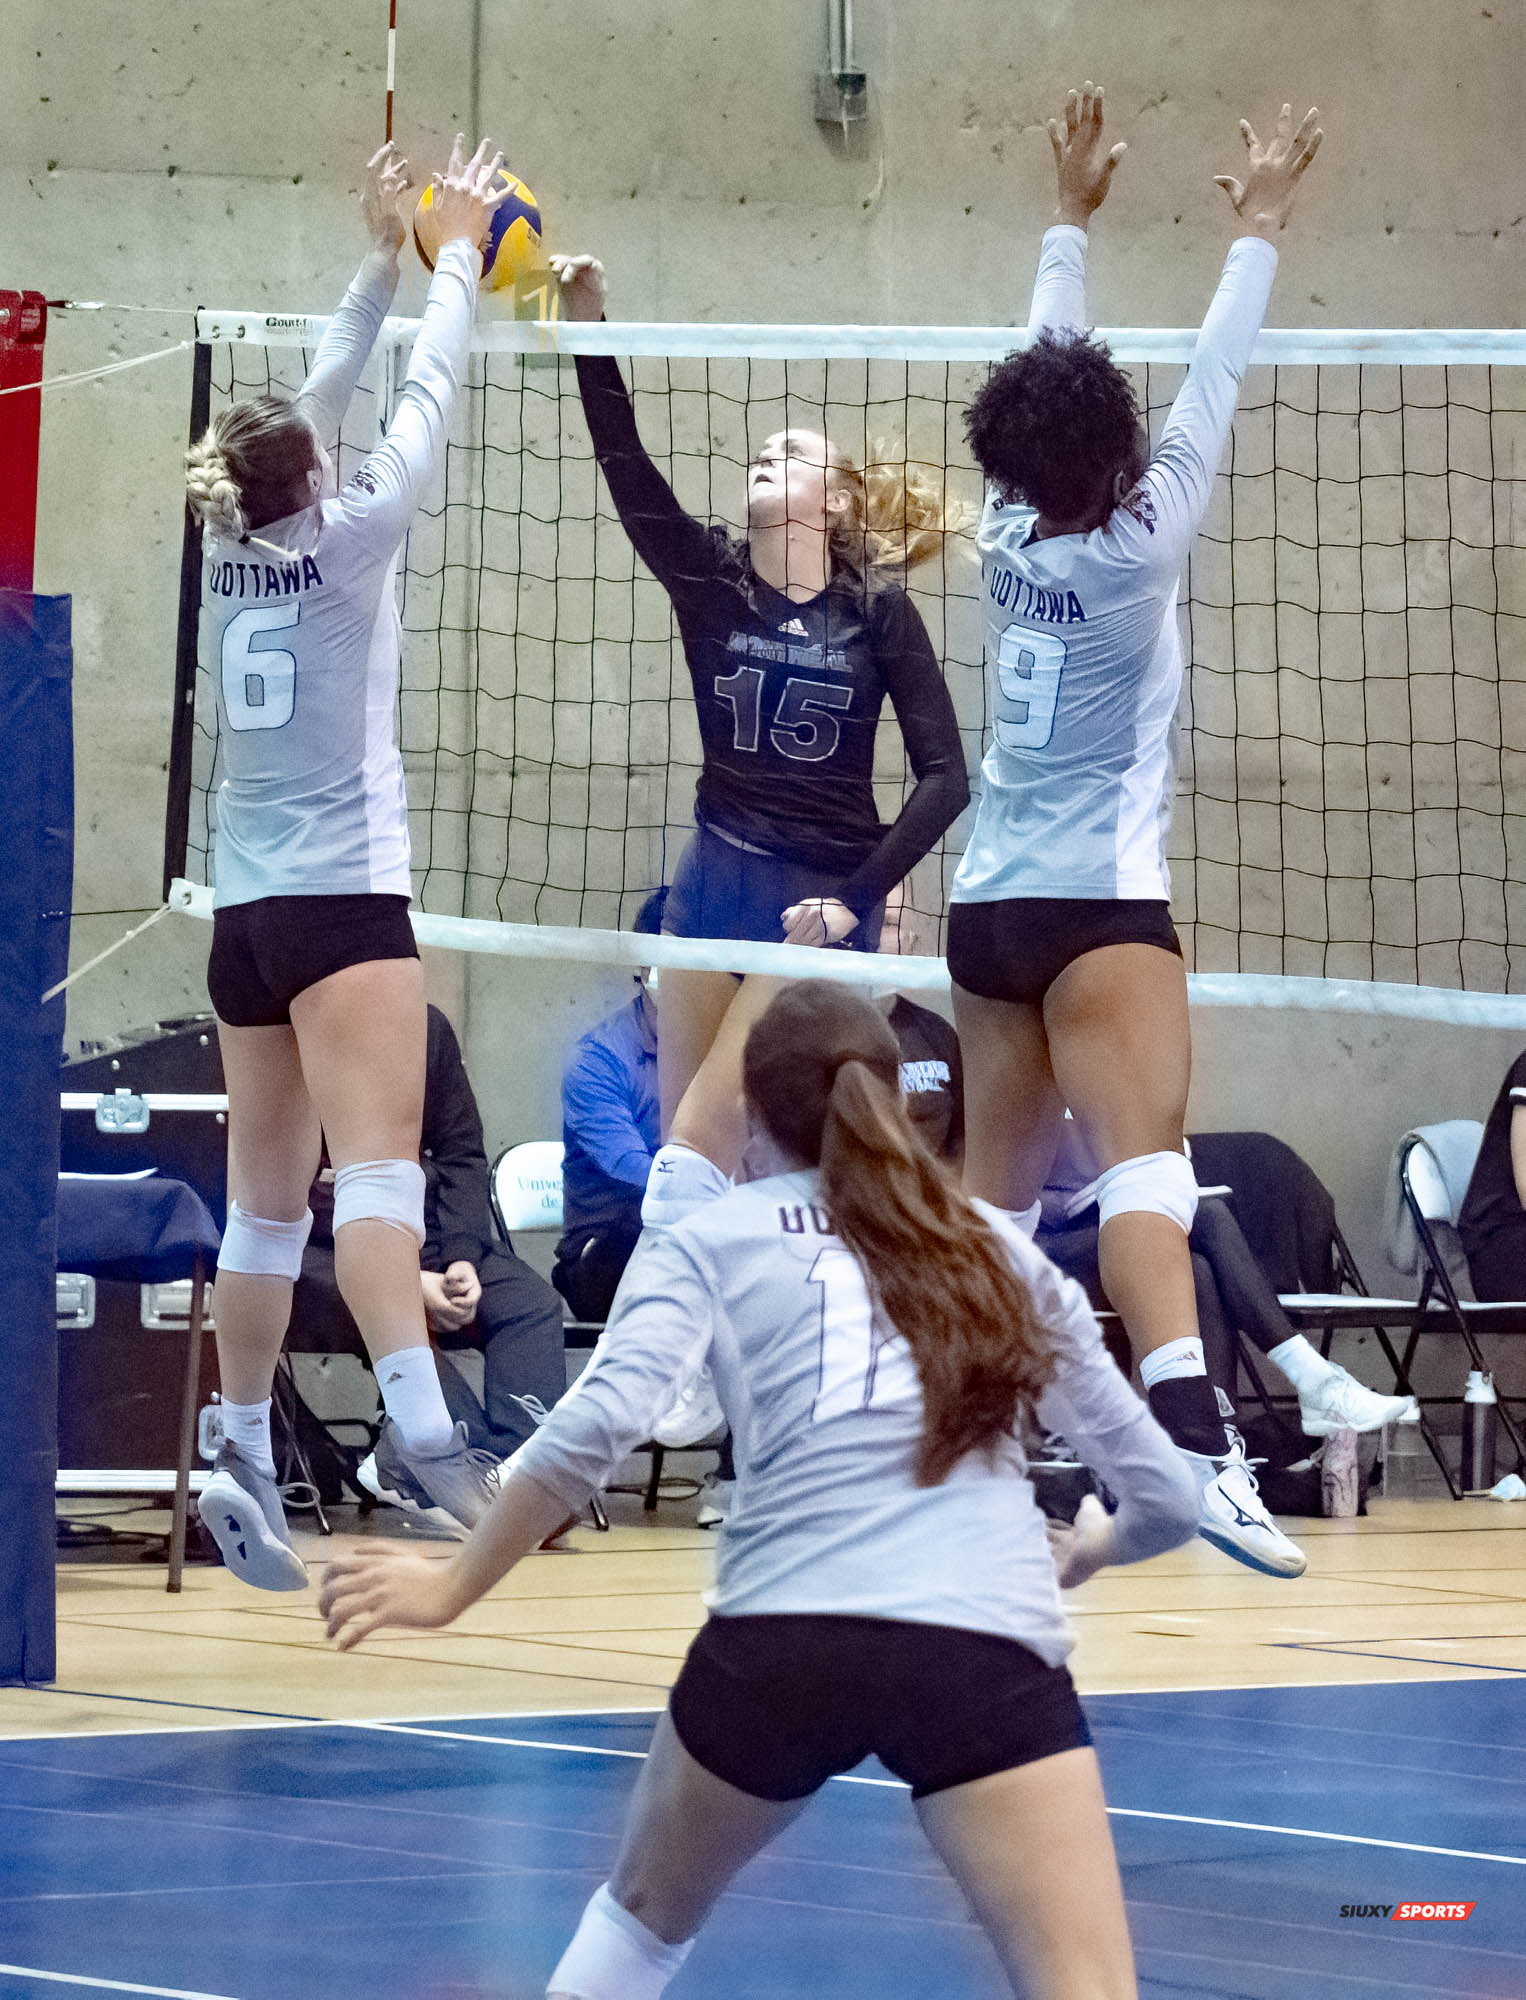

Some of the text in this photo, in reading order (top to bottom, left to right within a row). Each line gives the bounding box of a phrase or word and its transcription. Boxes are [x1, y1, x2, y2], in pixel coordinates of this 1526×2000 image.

[210, 554, 323, 598] UOTTAWA
[990, 566, 1088, 624] UOTTAWA
[220, 600, 301, 733] 6
[714, 665, 855, 762] 15
[995, 622, 1068, 751] 9
